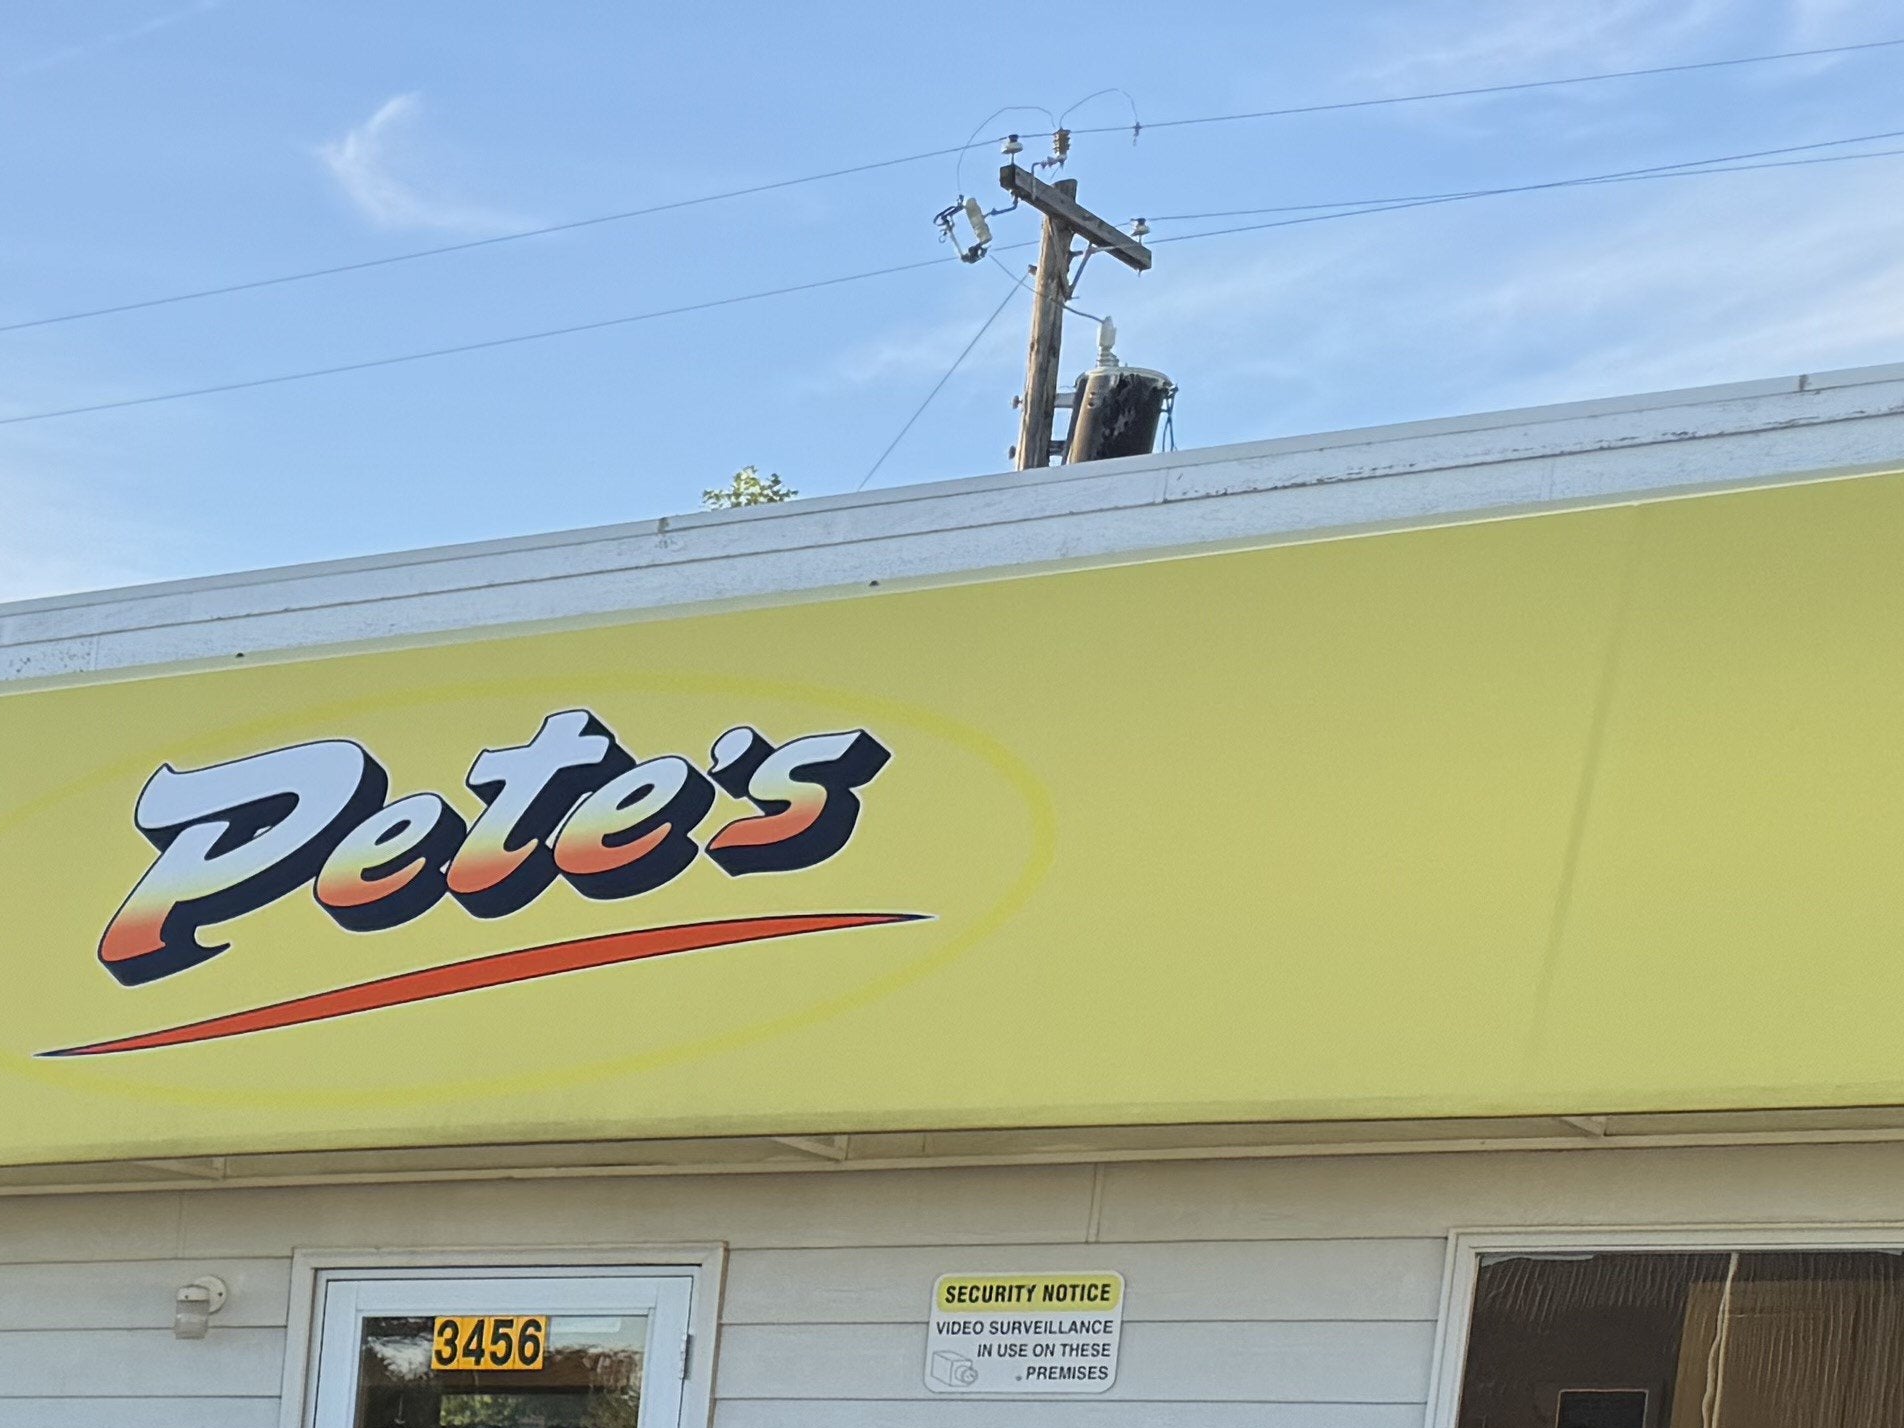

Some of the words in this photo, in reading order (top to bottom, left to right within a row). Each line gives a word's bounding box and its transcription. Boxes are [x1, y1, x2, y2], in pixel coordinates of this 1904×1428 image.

[97, 708, 892, 986] Pete's
[944, 1284, 1037, 1304] SECURITY
[1042, 1282, 1112, 1303] NOTICE
[936, 1320, 985, 1336] VIDEO
[989, 1319, 1114, 1335] SURVEILLANCE
[434, 1317, 543, 1367] 3456
[977, 1344, 993, 1358] IN
[997, 1344, 1029, 1358] USE
[1032, 1344, 1057, 1358] ON
[1060, 1343, 1111, 1357] THESE
[1025, 1365, 1109, 1381] PREMISES
